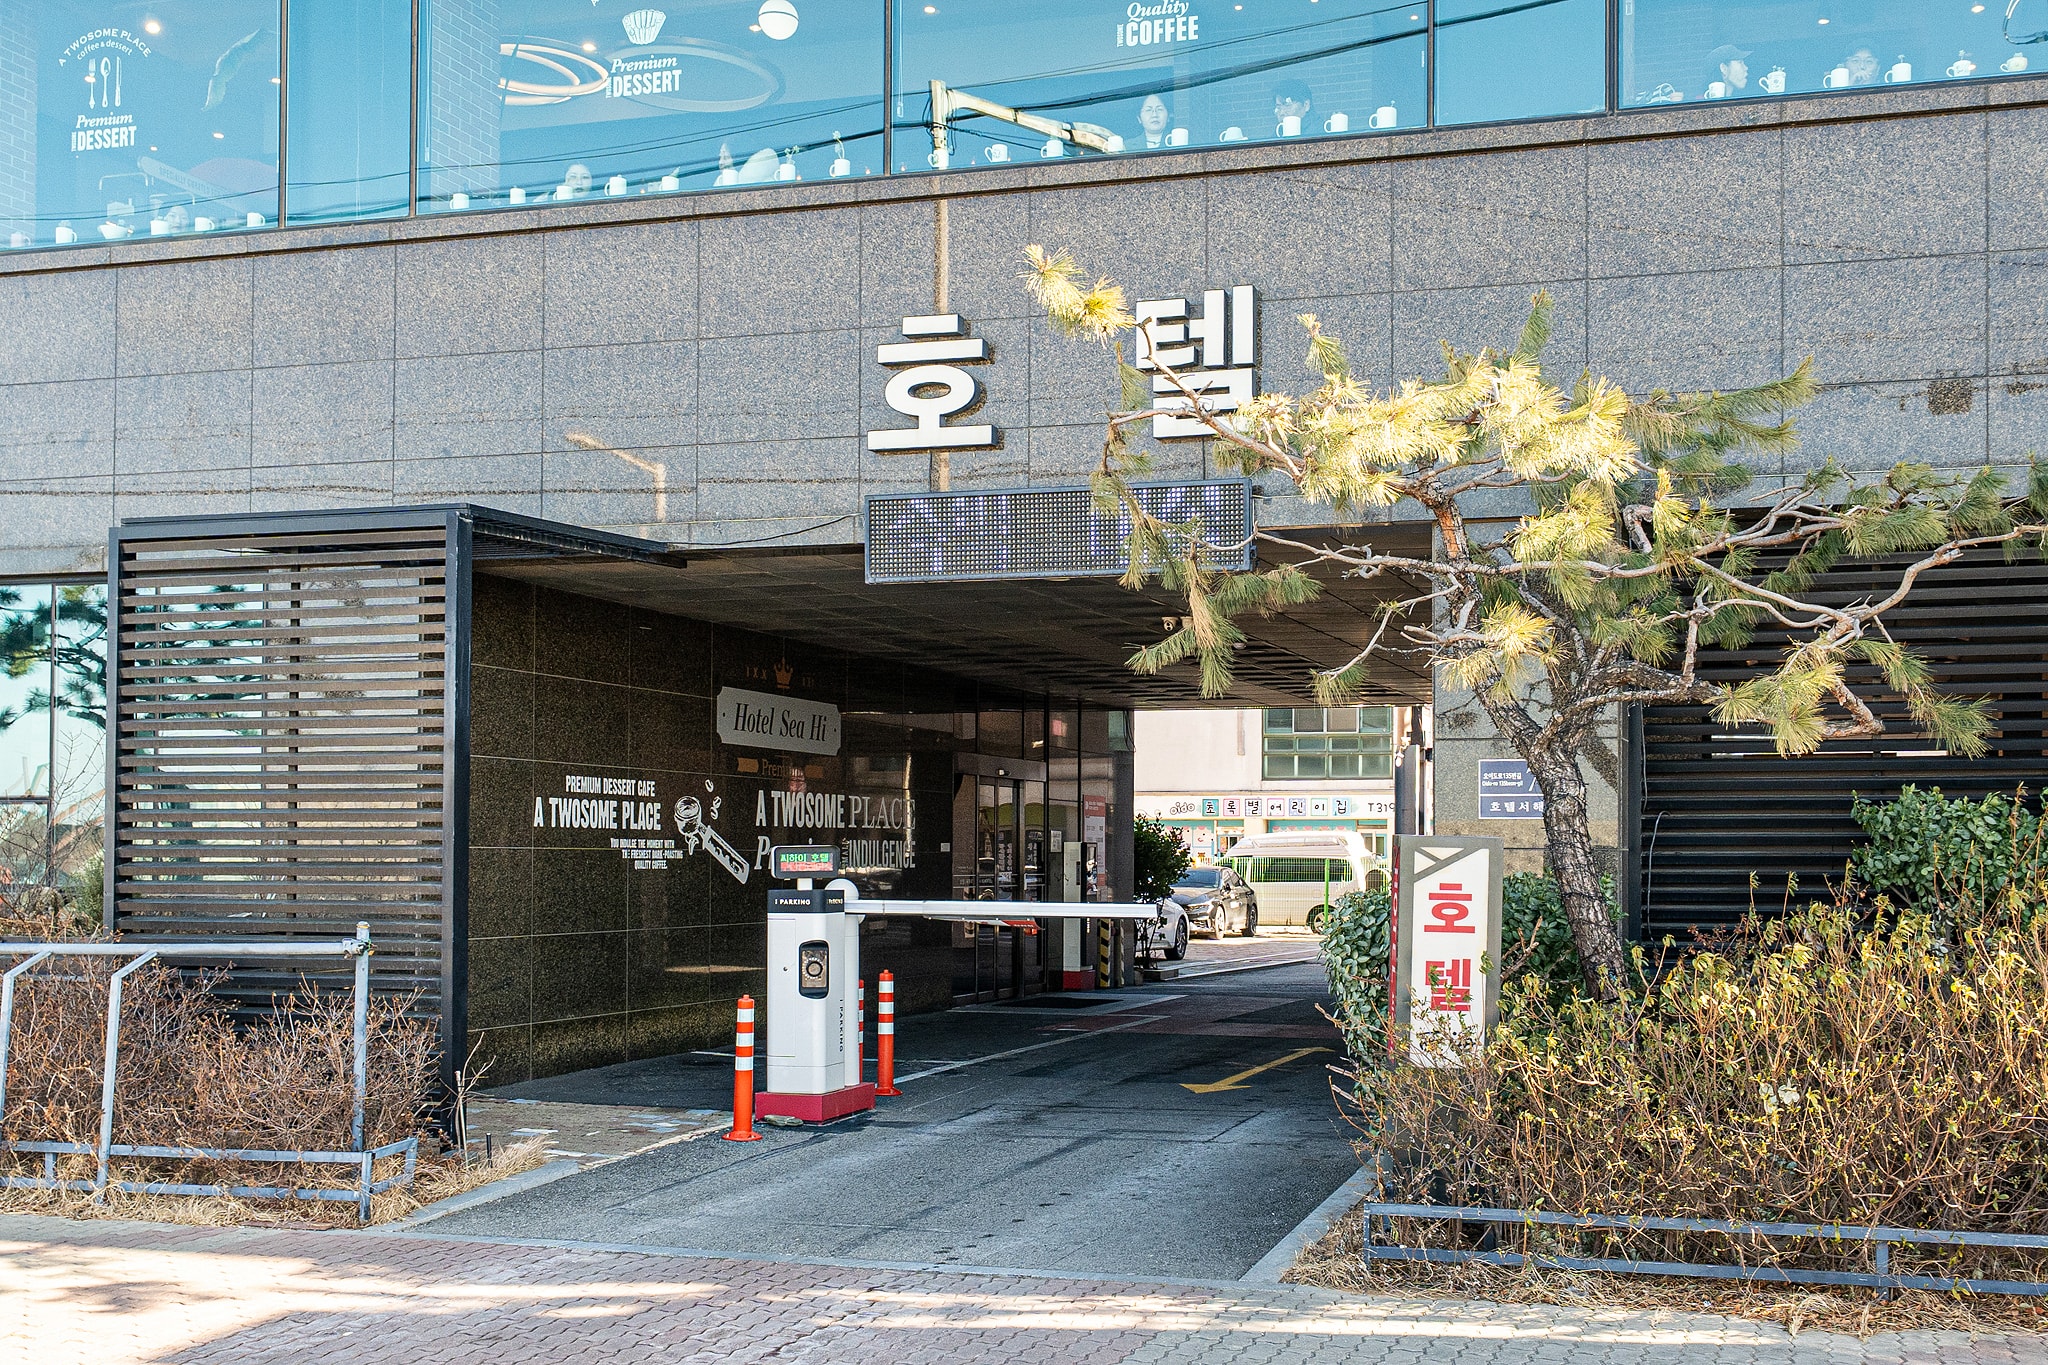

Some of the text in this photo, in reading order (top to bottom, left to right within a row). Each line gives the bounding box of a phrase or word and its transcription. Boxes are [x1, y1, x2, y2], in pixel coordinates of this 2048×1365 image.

[1127, 0, 1189, 22] Quality
[1126, 15, 1199, 47] COFFEE
[58, 28, 152, 67] A TWOSOME PLACE
[76, 41, 100, 60] coffee
[105, 39, 133, 56] dessert
[611, 54, 678, 74] Premium
[613, 69, 683, 98] DESSERT
[75, 111, 133, 128] Premium
[77, 125, 137, 151] DESSERT
[867, 285, 1256, 452] 호텔
[734, 702, 827, 741] Hotel Sea Hi
[566, 775, 656, 797] PREMIUM DESSERT CAFE
[533, 796, 662, 831] A TWOSOME PLACE
[755, 789, 916, 830] A TWOSOME PLACE
[1169, 801, 1196, 815] oido
[849, 839, 916, 869] INDULGENCE
[1423, 882, 1476, 1012] 호텔
